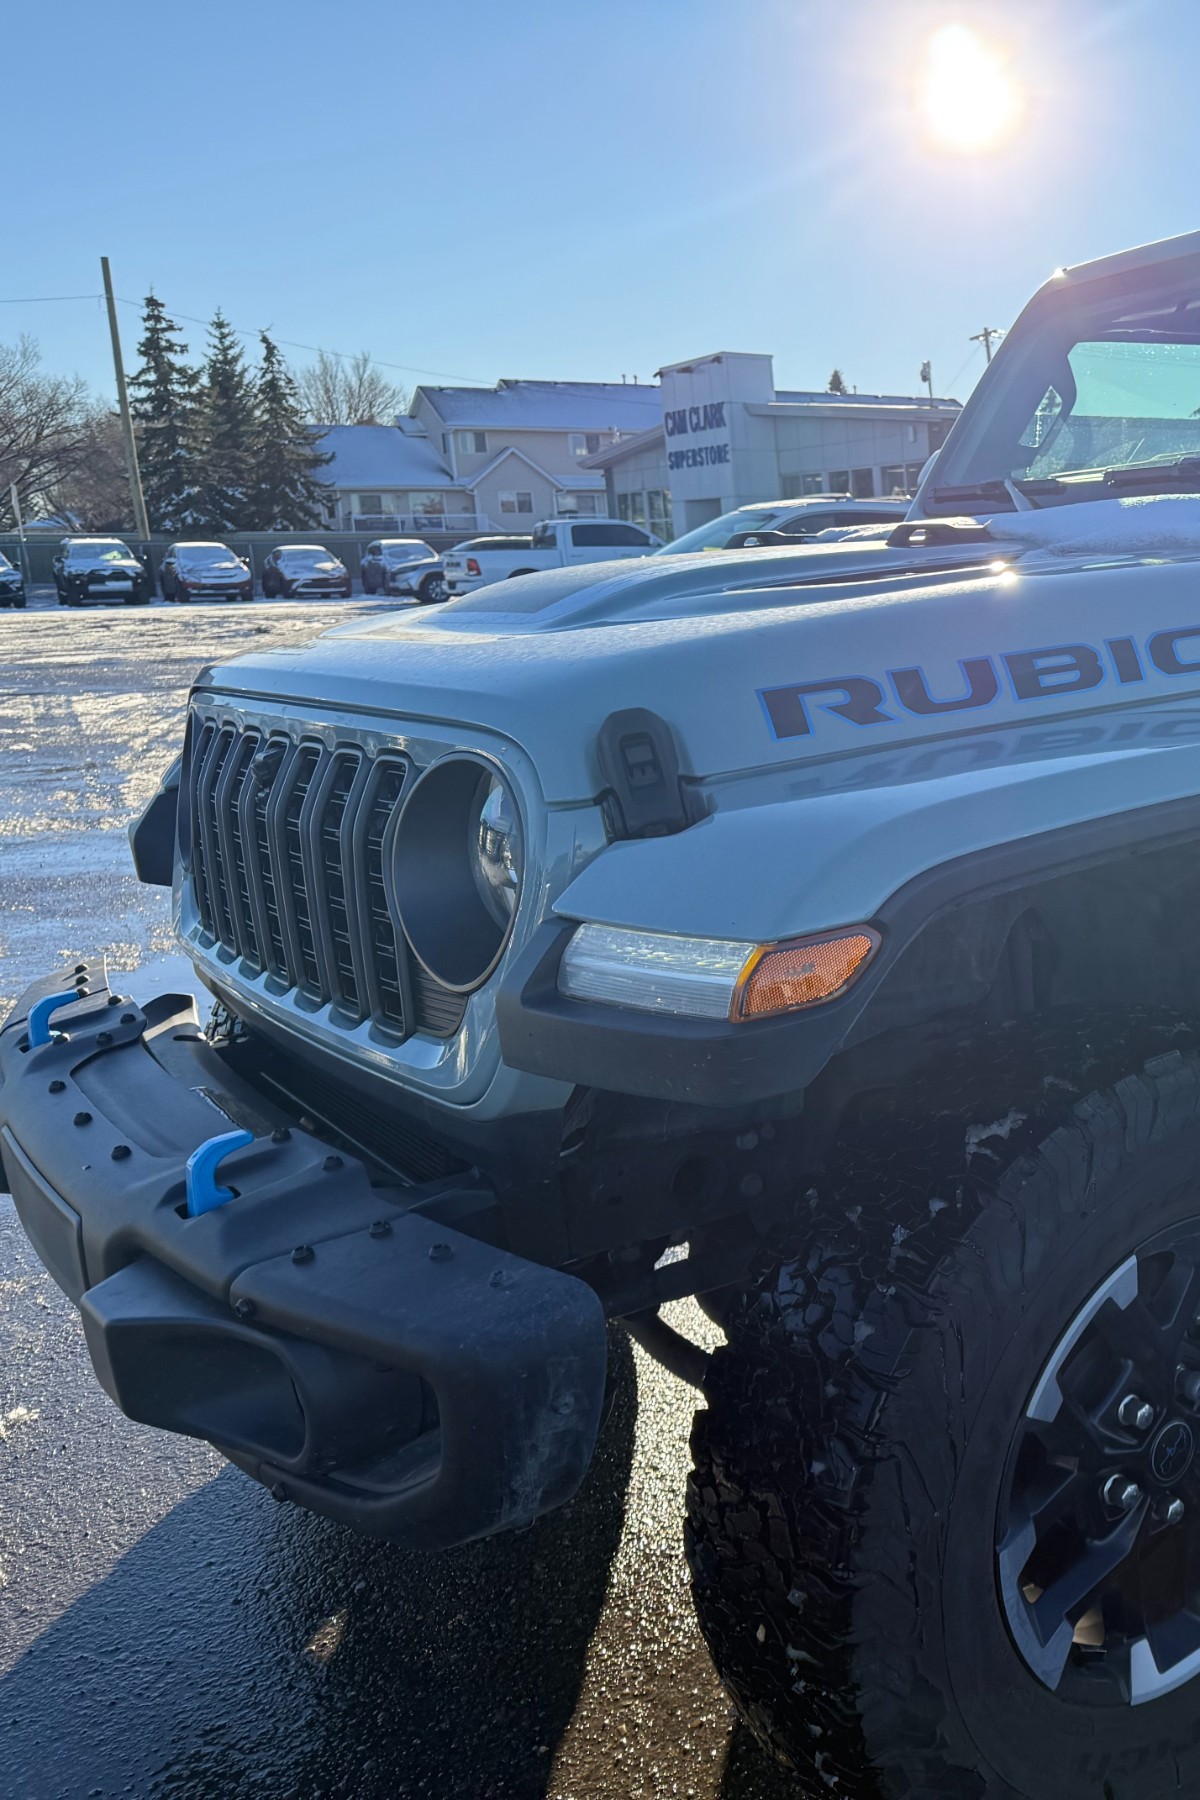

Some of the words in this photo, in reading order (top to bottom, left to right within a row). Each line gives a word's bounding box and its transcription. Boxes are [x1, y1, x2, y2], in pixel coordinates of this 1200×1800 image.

[665, 410, 688, 437] CAM
[689, 402, 726, 432] CLARK
[668, 444, 730, 470] SUPERSTORE
